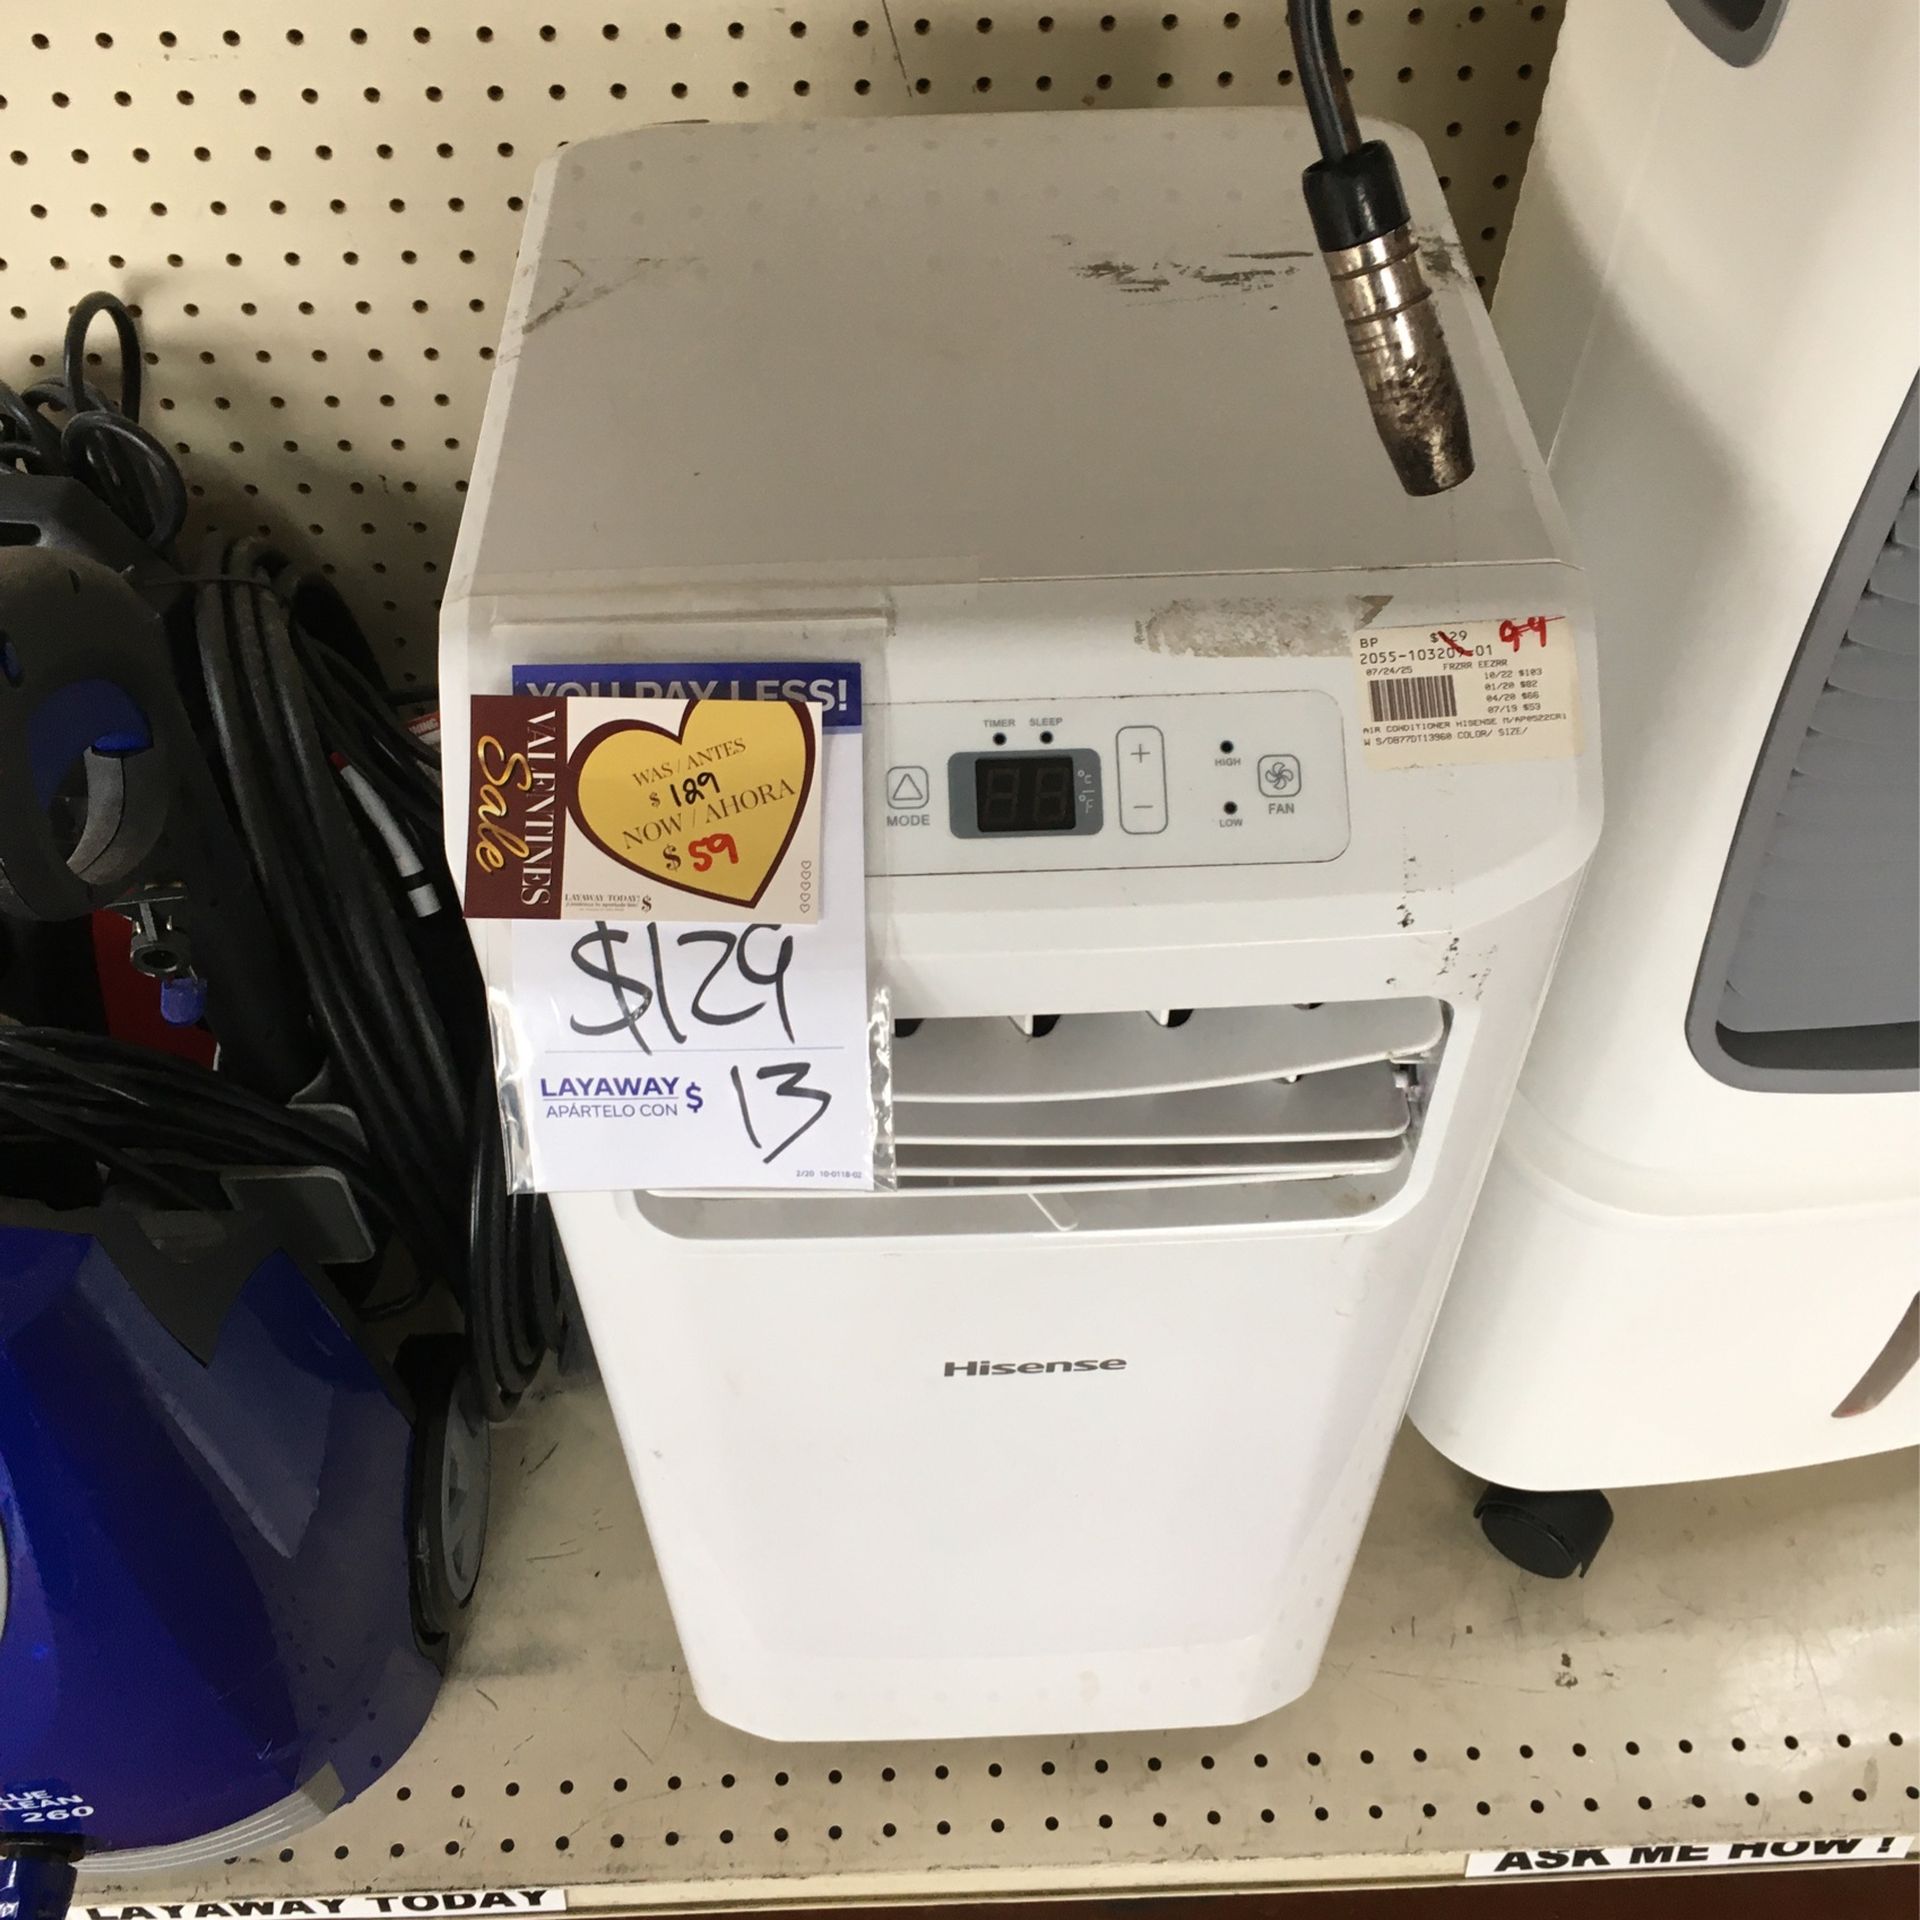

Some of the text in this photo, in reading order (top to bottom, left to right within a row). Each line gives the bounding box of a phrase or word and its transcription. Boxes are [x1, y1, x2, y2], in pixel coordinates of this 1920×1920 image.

[1359, 630, 1468, 649] BP $29
[1366, 666, 1413, 676] 07/24/25
[1484, 667, 1543, 680] 10/22 $103
[1484, 679, 1538, 691] 01/20 $82
[1486, 693, 1516, 702] 04/20
[1487, 702, 1541, 714] 07/19 $53
[983, 717, 1063, 728] TIMER SLEEP
[1363, 726, 1381, 735] AIR
[1386, 721, 1451, 733] CONDITIONER
[1456, 717, 1497, 727] HISENSE
[1364, 738, 1371, 746] W
[1457, 729, 1493, 740] COLOR/
[1498, 726, 1529, 737] SIZE/
[633, 761, 674, 787] WAS
[687, 737, 746, 770] ANTES
[1215, 757, 1241, 767] HIGH
[475, 735, 533, 874] Sale
[520, 710, 557, 906] VALENTINES
[622, 813, 683, 850] NOW
[705, 778, 796, 824] AHORA
[1268, 803, 1295, 815] FAN
[886, 815, 930, 827] MODE
[1219, 818, 1243, 828] LOW
[688, 833, 740, 873] 59
[570, 920, 794, 1056] $129
[540, 1076, 680, 1097] LAYAWAY
[546, 1102, 678, 1119] APÁRTELO CON
[730, 1062, 832, 1164] 13
[943, 1358, 1127, 1377] Hisense
[0, 1794, 84, 1812] LEAN
[20, 1805, 94, 1824] 260
[1494, 1848, 1611, 1872] ASK
[1629, 1846, 1709, 1865] ME
[1728, 1838, 1863, 1860] HOW
[82, 1889, 548, 1920] LAYAWAY TODAY
